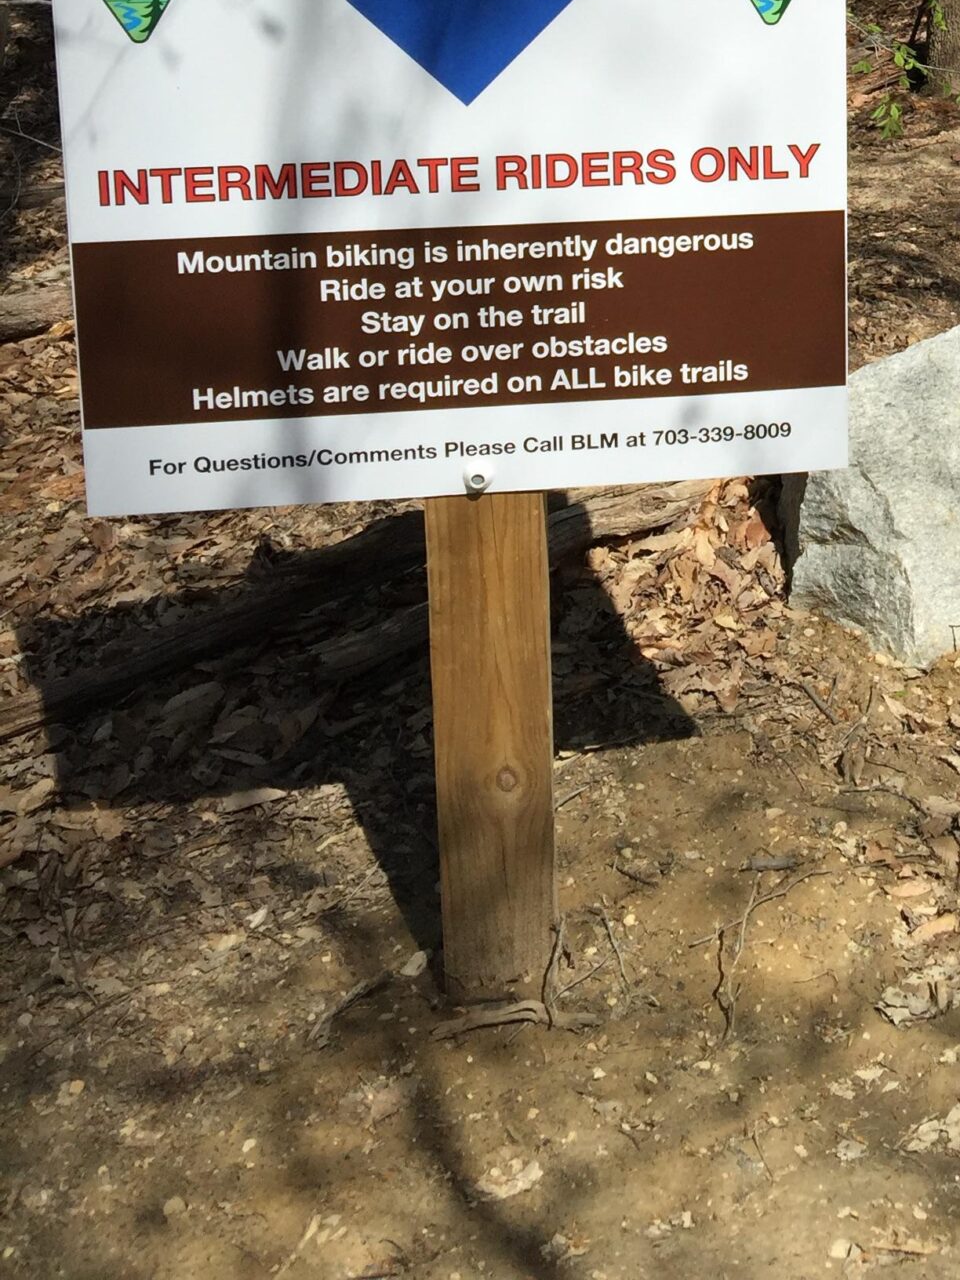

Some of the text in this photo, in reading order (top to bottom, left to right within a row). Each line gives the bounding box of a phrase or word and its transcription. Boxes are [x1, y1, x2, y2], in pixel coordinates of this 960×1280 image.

[98, 143, 821, 206] INTERMEDIATE RIDERS ONLY
[177, 232, 754, 274] Mountain biking is inherently dangerous
[320, 266, 625, 302] Ride at your own risk
[361, 301, 586, 337] Stay on the trail
[277, 332, 668, 371] Walk or ride over obstacles
[192, 359, 749, 410] Helmets are required on ALL bike trails
[149, 422, 792, 476] For Questions/Comments Please Call BLM at 703-339-8009
